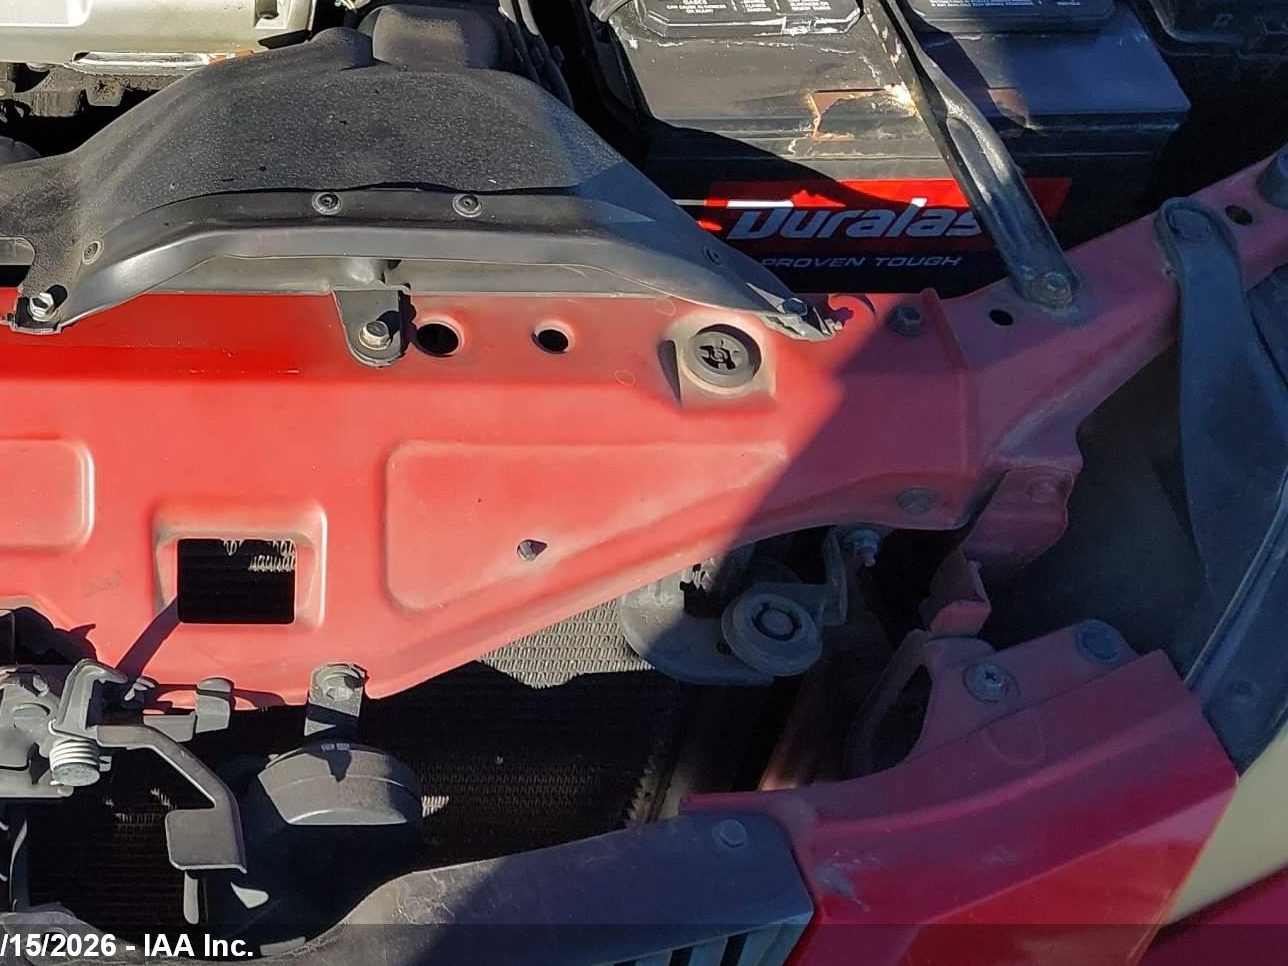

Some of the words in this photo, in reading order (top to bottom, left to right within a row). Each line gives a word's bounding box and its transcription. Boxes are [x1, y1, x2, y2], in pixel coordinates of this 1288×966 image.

[726, 197, 984, 240] Duralas
[760, 257, 865, 268] PROVEN
[874, 256, 962, 267] TOUGH
